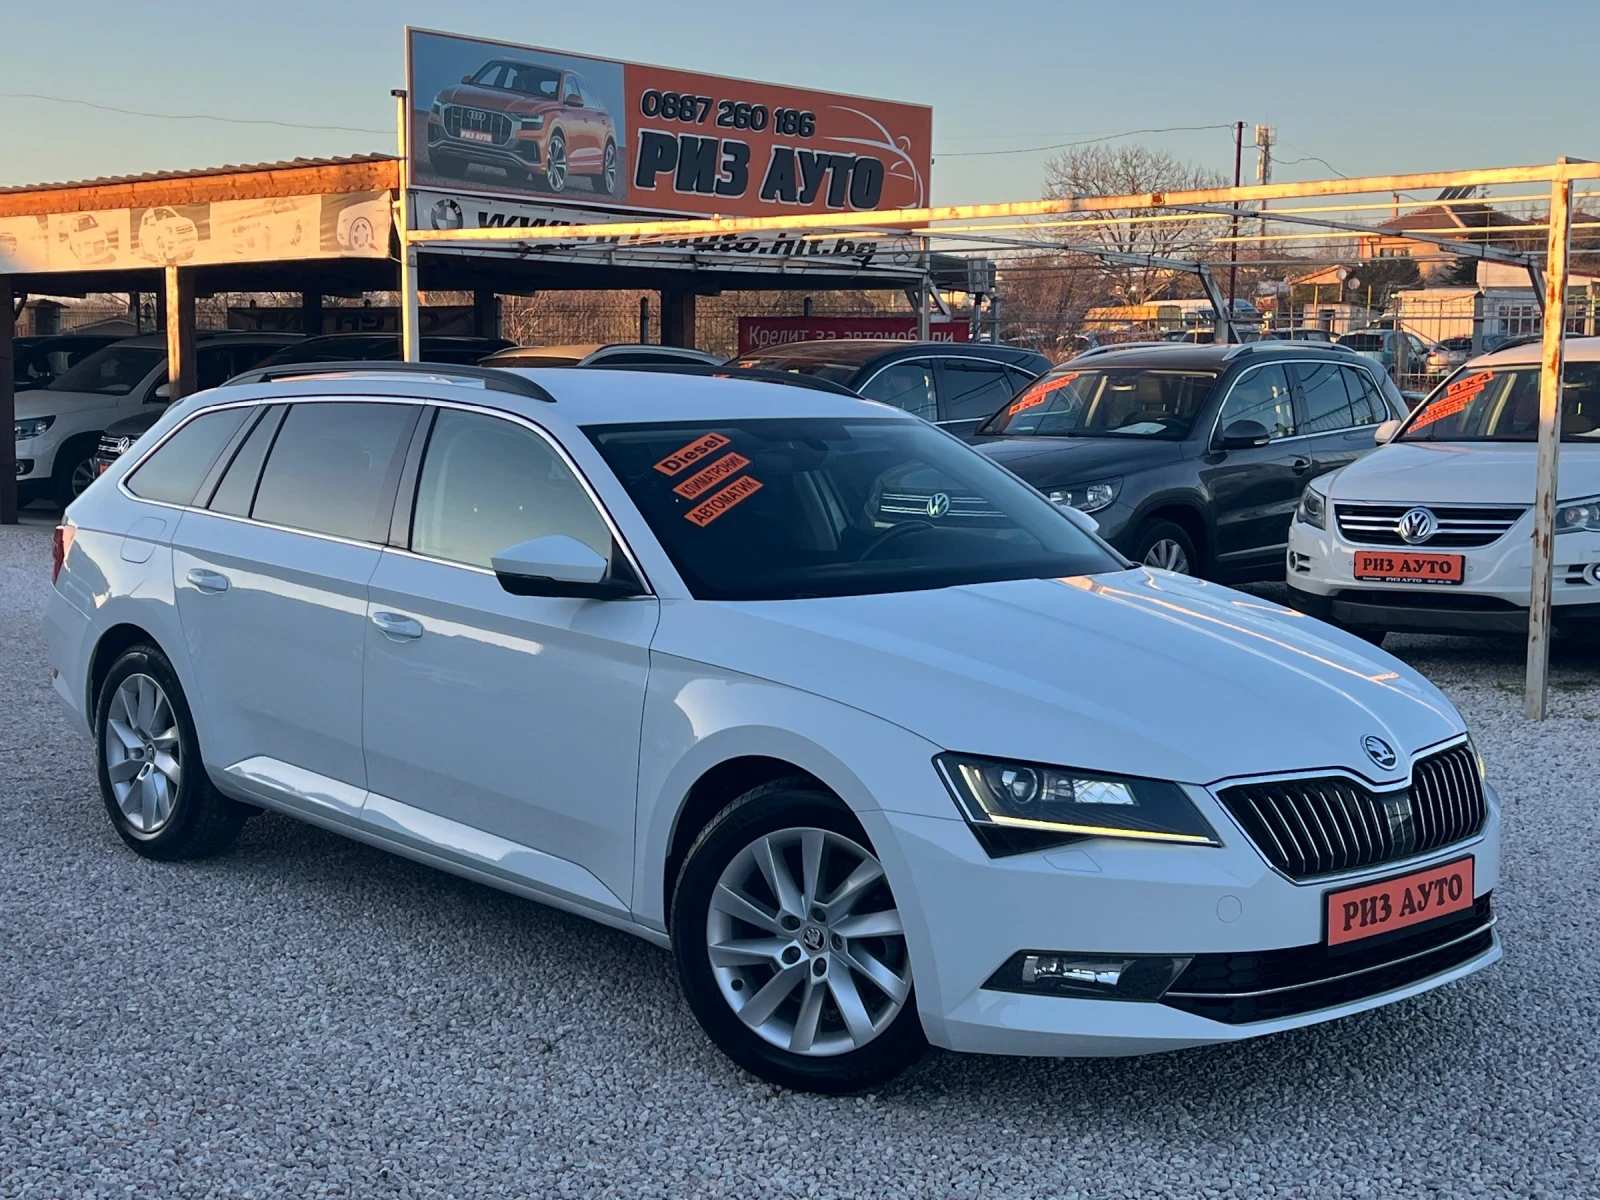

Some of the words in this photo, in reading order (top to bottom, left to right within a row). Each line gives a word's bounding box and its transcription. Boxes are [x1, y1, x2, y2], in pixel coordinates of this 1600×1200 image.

[641, 88, 713, 125] 0887
[716, 98, 768, 132] 260
[772, 106, 815, 138] 186
[634, 128, 751, 198] РИЗ
[759, 145, 885, 210] АУТО
[750, 325, 809, 348] Кредит
[844, 326, 954, 342] автомобли
[661, 435, 724, 472] Diesel
[680, 454, 744, 496] КЛИМАТРОНИК
[693, 477, 758, 523] АВТОМАТИК
[1362, 557, 1394, 572] РИЗ
[1399, 559, 1452, 574] АУТО
[1343, 893, 1392, 931] РИЗ
[1399, 873, 1462, 916] АУТО
